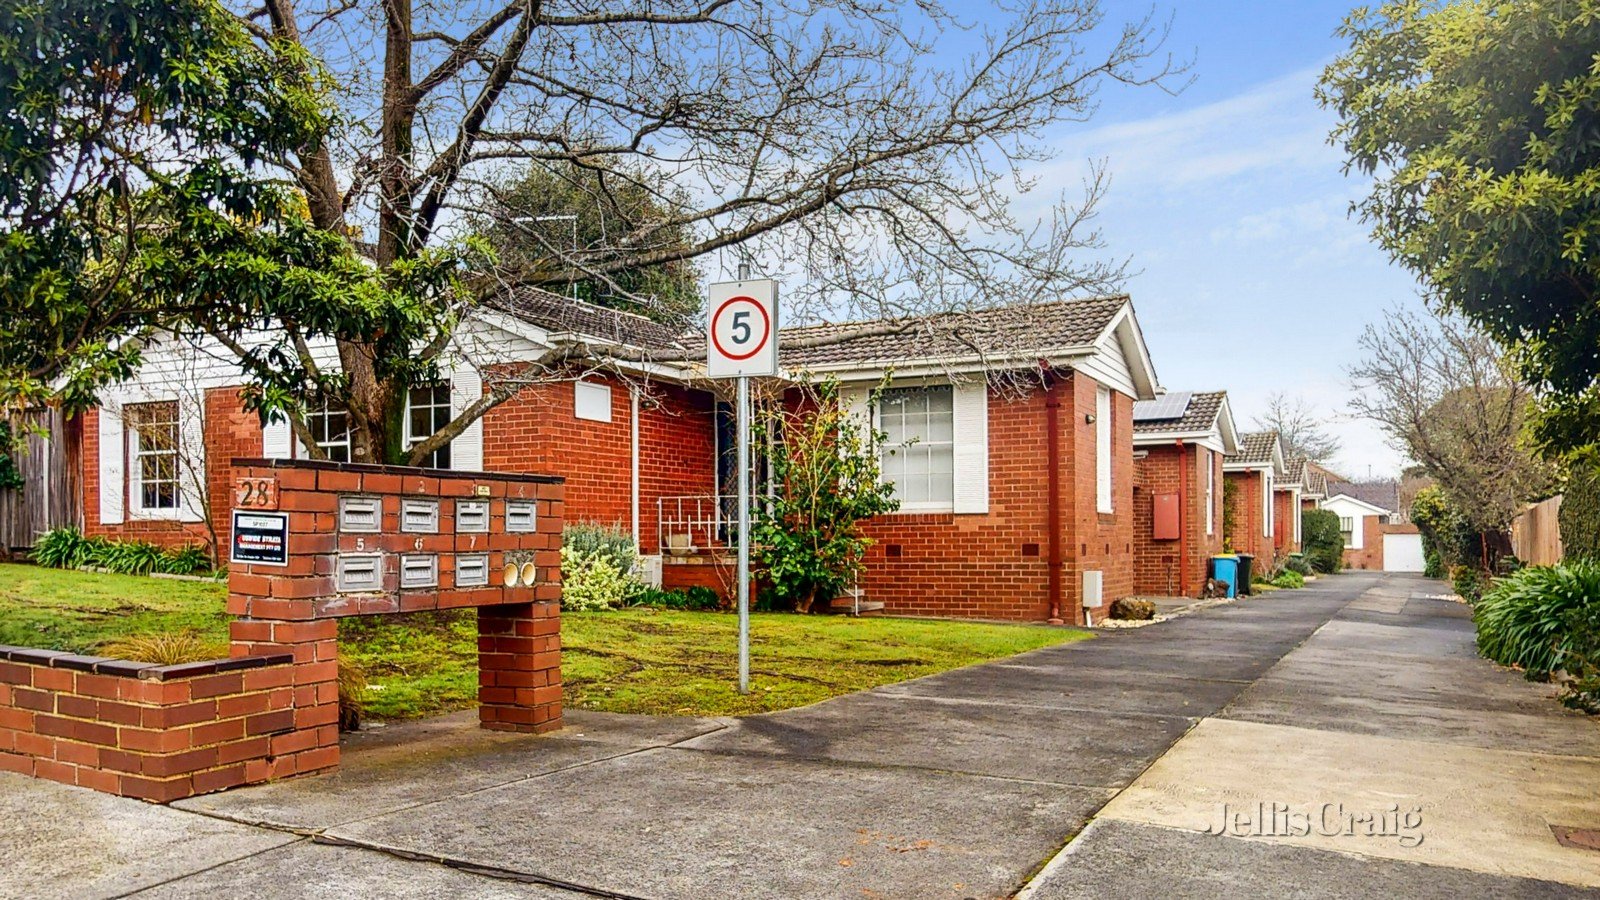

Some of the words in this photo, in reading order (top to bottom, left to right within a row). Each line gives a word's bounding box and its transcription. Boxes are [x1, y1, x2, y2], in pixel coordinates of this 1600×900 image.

[731, 311, 751, 344] 5
[417, 480, 426, 493] 2
[240, 480, 269, 507] 28
[356, 538, 365, 551] 5
[414, 538, 424, 551] 6
